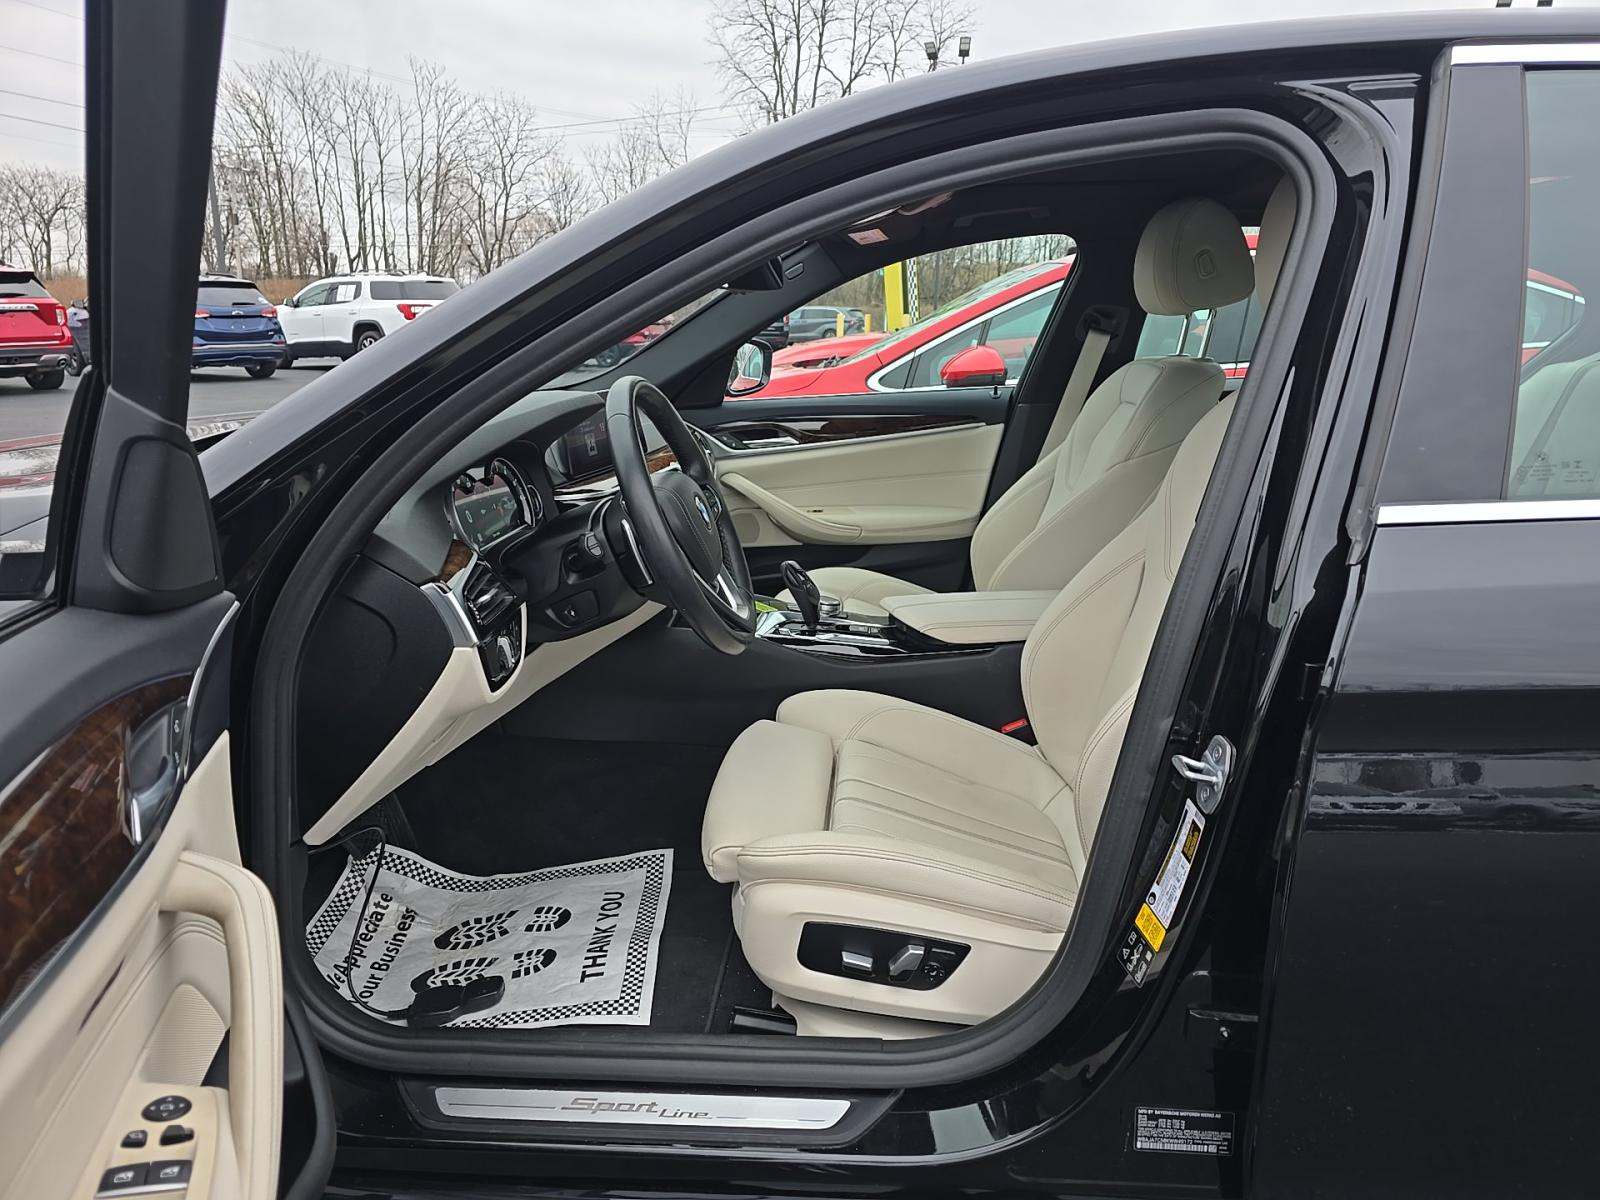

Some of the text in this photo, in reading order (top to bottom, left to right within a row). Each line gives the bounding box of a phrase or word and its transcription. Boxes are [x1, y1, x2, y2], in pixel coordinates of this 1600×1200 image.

[333, 893, 393, 978] Appreciate
[370, 907, 418, 972] Business
[580, 891, 625, 983] THANK YOU
[561, 1097, 712, 1119] Sport Line
